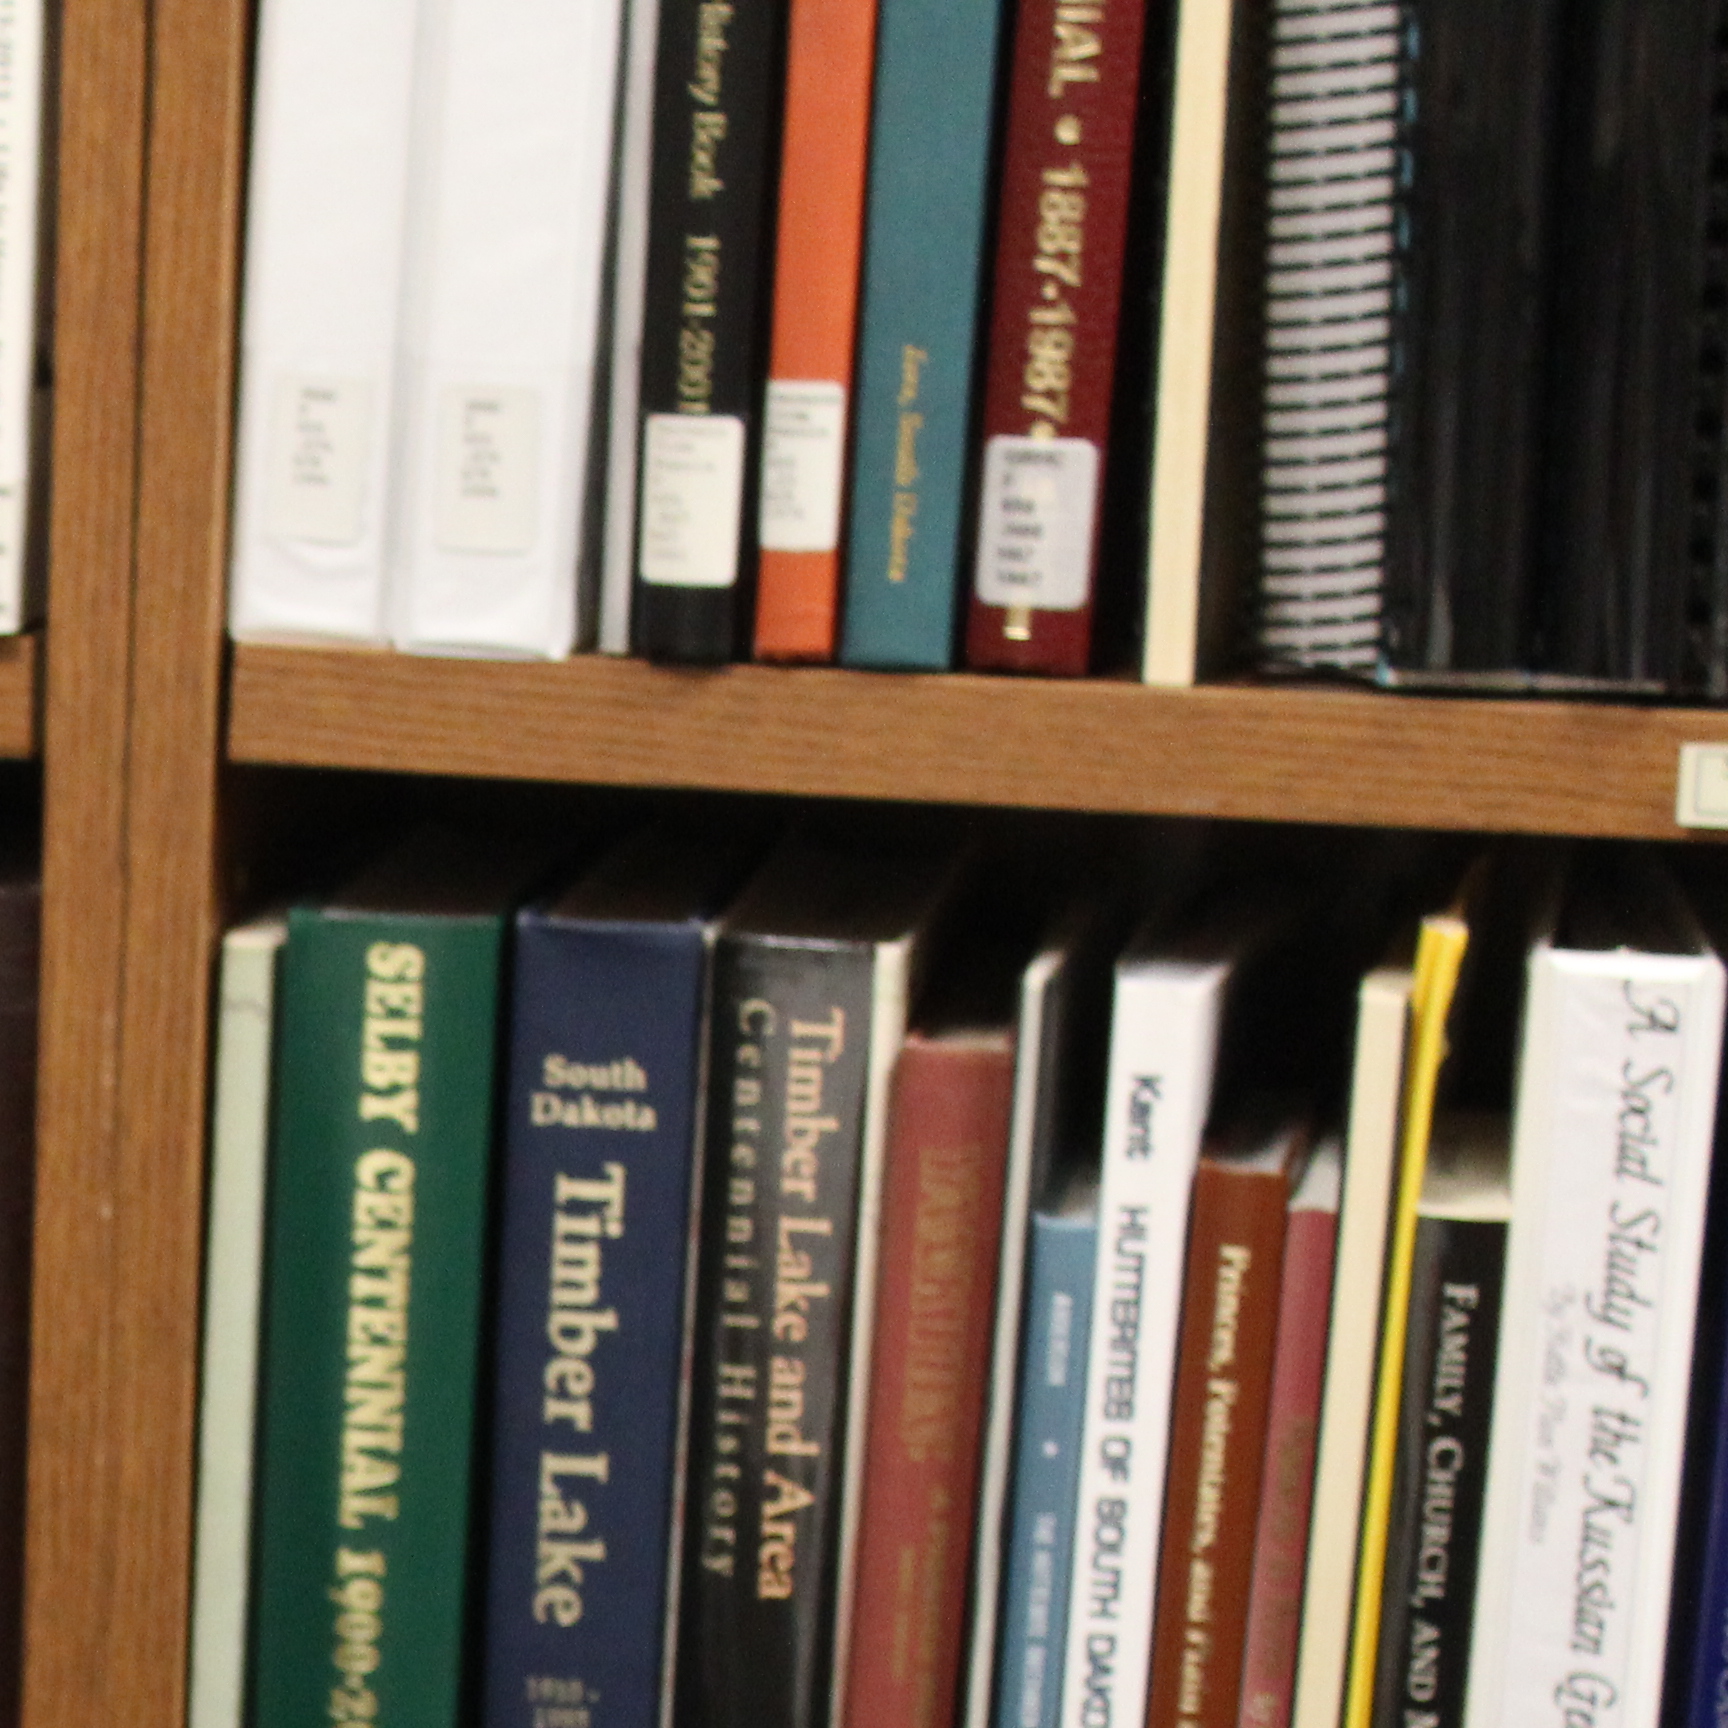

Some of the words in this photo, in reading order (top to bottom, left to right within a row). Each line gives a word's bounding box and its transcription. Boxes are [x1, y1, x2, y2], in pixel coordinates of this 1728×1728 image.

[689, 112, 730, 199] Book
[359, 942, 425, 1136] SELBY
[543, 1053, 648, 1092] South
[1621, 980, 1681, 1040] A
[530, 1092, 658, 1132] Dakota
[721, 1000, 777, 1328] Centennial
[782, 1004, 845, 1204] Timber
[1612, 1057, 1676, 1188] Social
[546, 1162, 627, 1432] Timber
[773, 1214, 834, 1343] Lake
[1102, 1202, 1153, 1423] HUTTERITES
[1586, 1200, 1663, 1333] Study
[337, 1150, 416, 1532] CENTENNIAL
[766, 1355, 819, 1457] and
[1585, 1337, 1652, 1398] of
[700, 1363, 758, 1579] History
[1097, 1436, 1133, 1484] OF
[1589, 1404, 1642, 1466] the
[533, 1450, 608, 1627] Lake
[757, 1469, 816, 1600] Area
[1085, 1495, 1129, 1621] SOUTH
[1568, 1473, 1637, 1658] Russian
